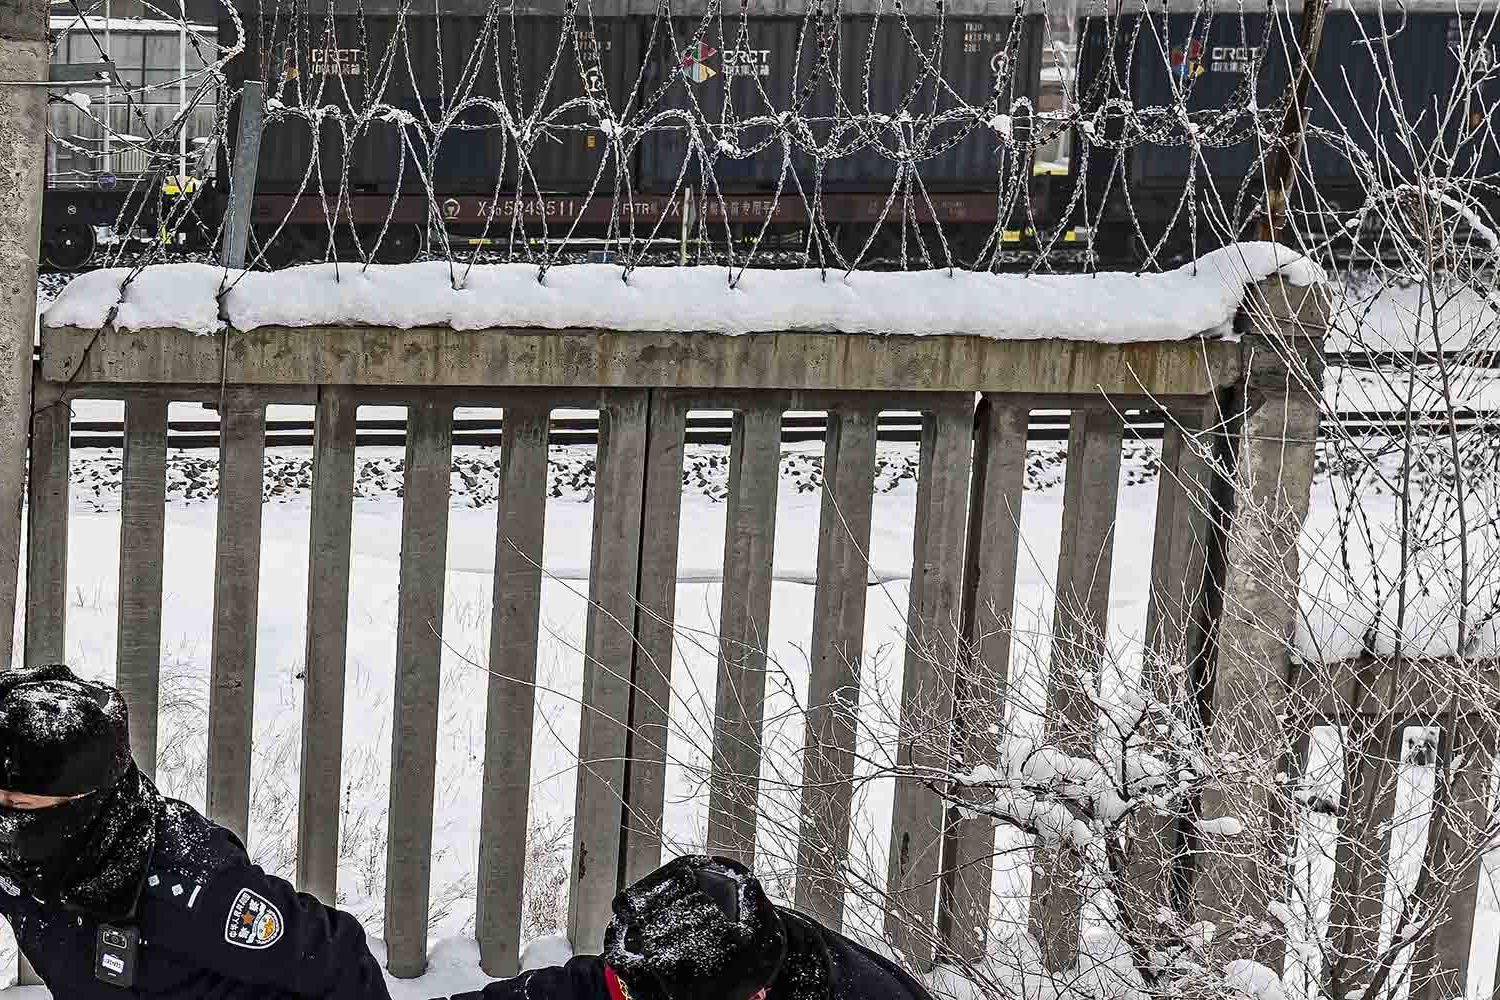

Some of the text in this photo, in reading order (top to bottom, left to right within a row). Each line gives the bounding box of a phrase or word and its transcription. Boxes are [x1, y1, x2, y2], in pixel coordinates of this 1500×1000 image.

[312, 48, 360, 62] CRCT
[722, 49, 771, 63] CRCT
[1211, 47, 1258, 60] CRCT
